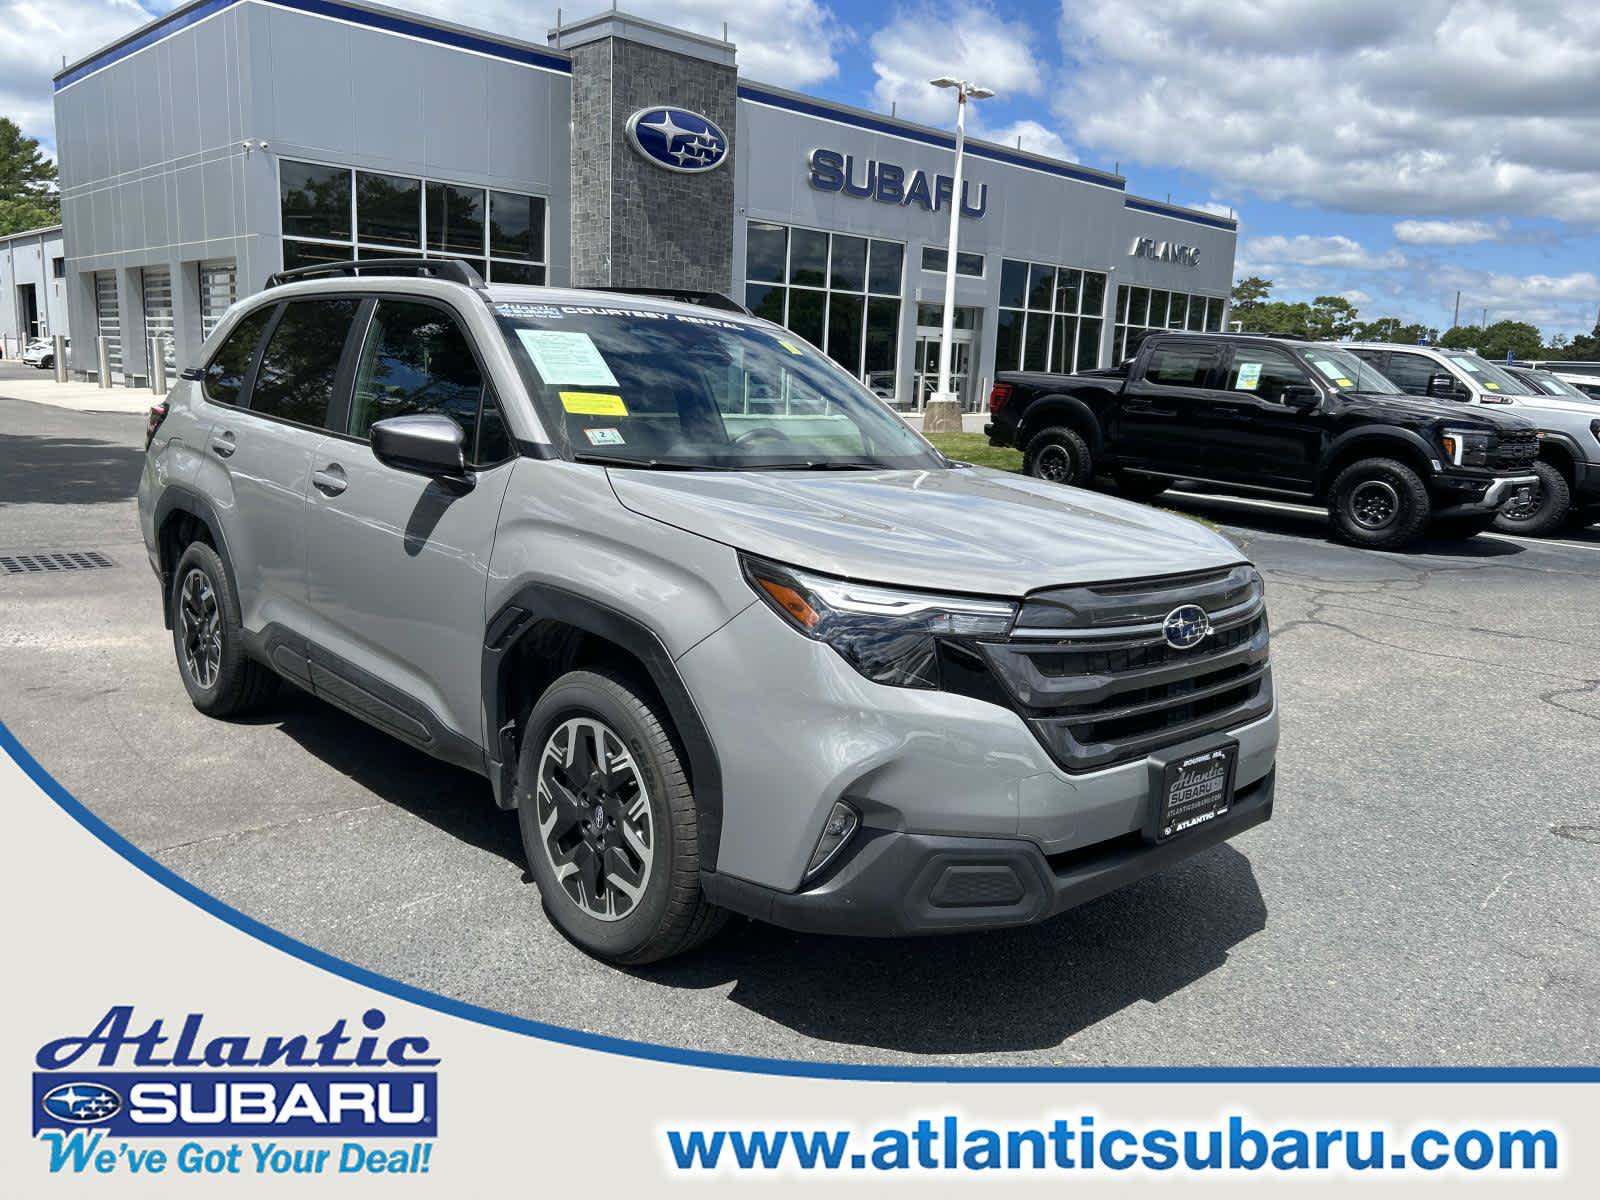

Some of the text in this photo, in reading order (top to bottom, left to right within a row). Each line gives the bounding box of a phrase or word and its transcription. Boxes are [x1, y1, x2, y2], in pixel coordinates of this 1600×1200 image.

[808, 148, 988, 219] SUBARU
[1129, 236, 1201, 267] ATLANTIC
[561, 307, 669, 320] COURTESY
[675, 315, 745, 331] RENTAL
[1170, 762, 1225, 792] Atlantic
[1171, 781, 1212, 805] SUBARU
[1176, 811, 1215, 832] ATLANTIC
